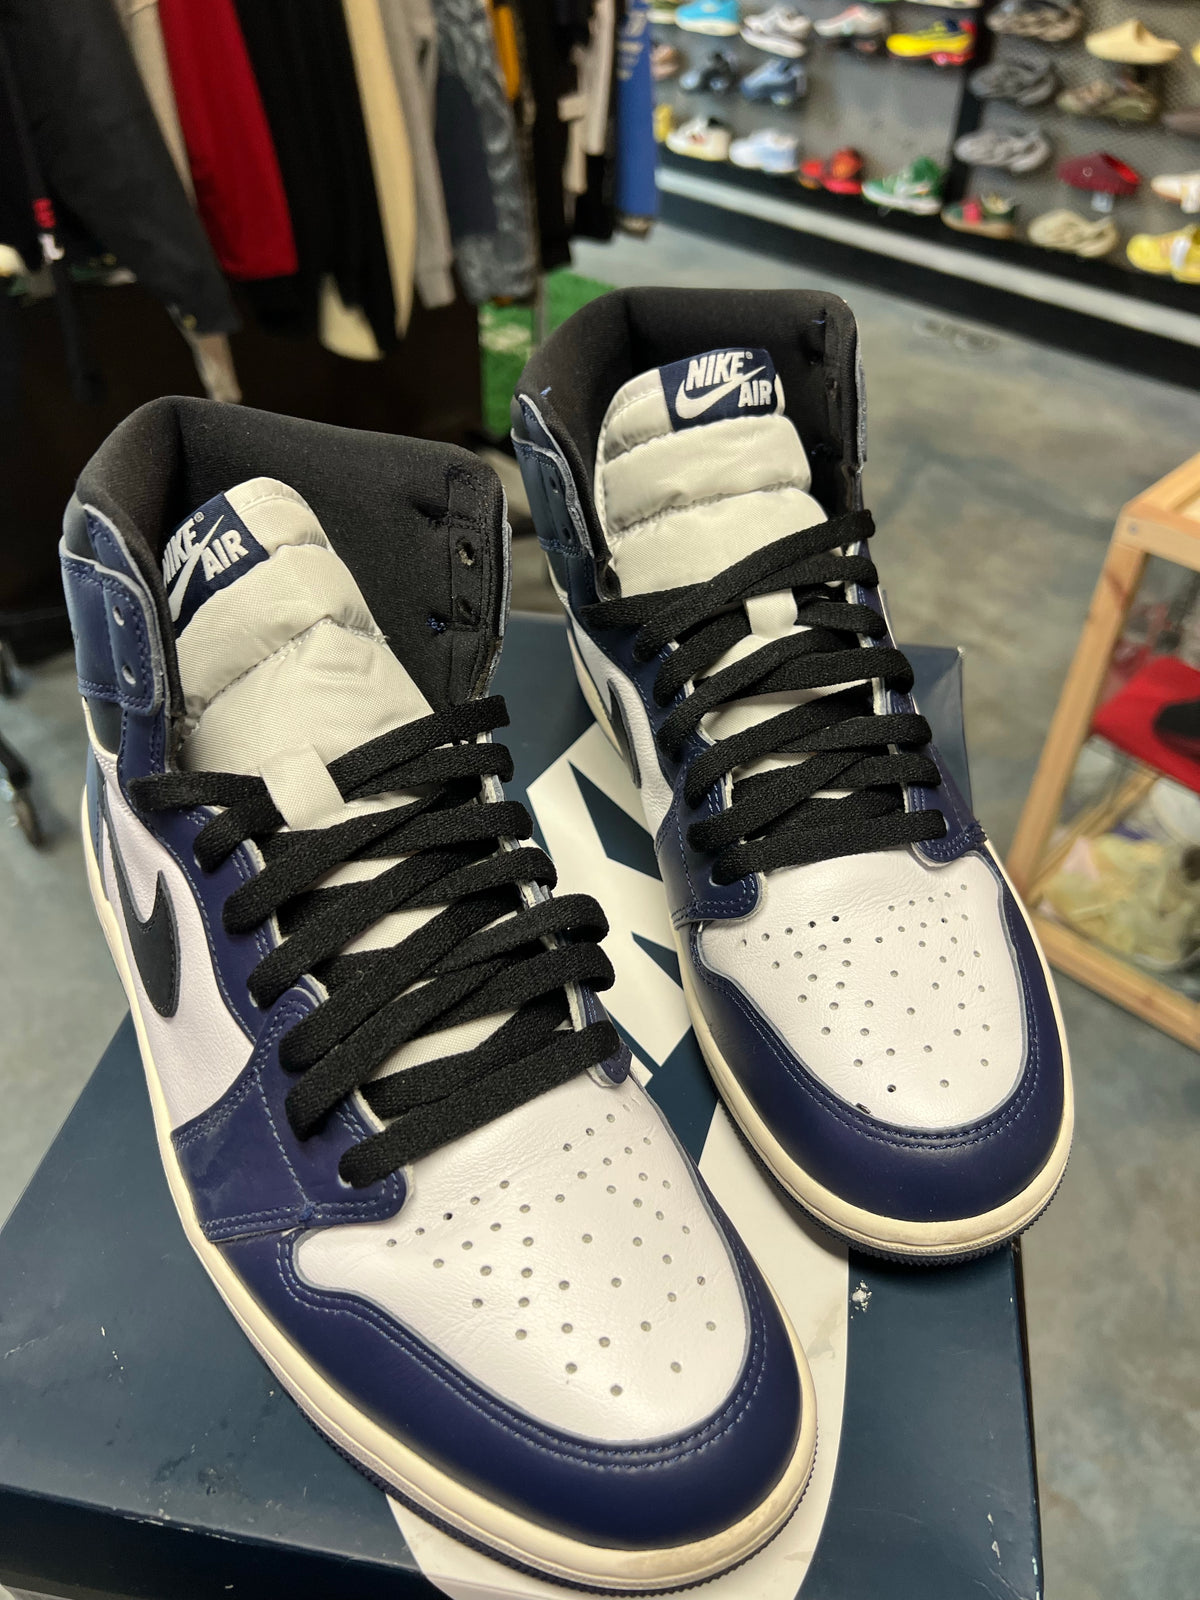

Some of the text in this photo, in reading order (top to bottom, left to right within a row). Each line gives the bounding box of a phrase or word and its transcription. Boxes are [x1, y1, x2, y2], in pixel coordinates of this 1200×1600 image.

[686, 351, 745, 391] NIKE
[738, 379, 773, 408] AIR
[201, 529, 249, 582] AIR
